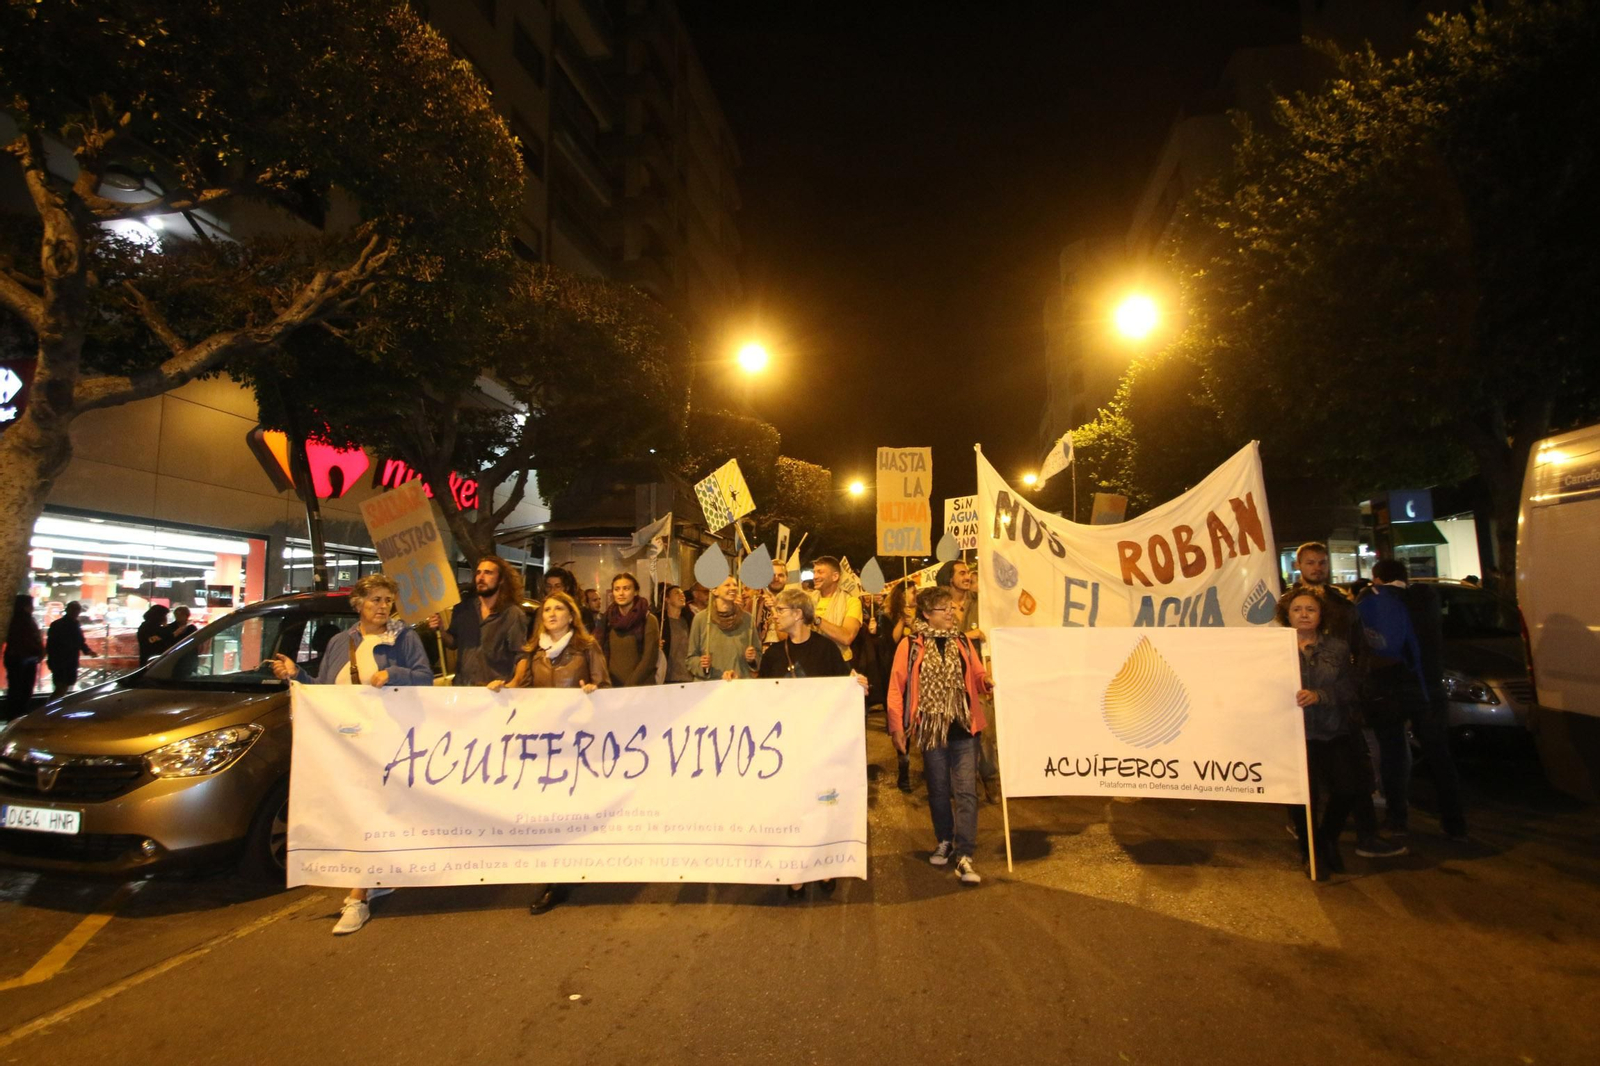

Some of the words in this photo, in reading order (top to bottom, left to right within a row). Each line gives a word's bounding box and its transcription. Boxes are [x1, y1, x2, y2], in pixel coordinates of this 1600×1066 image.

[879, 452, 926, 472] HASTA
[903, 477, 924, 498] LA
[949, 510, 978, 524] AGUA
[376, 520, 437, 560] NUESTRO
[883, 527, 924, 552] GOTA
[993, 490, 1066, 558] NOS
[1117, 491, 1266, 587] ROBAN
[395, 558, 446, 615] RÍO
[1062, 576, 1100, 627] EL
[1134, 586, 1225, 627] AGUA
[382, 708, 649, 796] ACUÍFEROS
[662, 721, 783, 779] VIVOS
[1044, 754, 1179, 779] ACUÍFEROS
[1193, 760, 1263, 783] VIVOS
[1100, 780, 1137, 789] Plataforma
[1149, 782, 1179, 791] Defensa
[1181, 783, 1192, 791] del
[1193, 784, 1213, 794] Agua
[1214, 785, 1224, 793] en
[9, 808, 40, 827] 0454
[49, 811, 75, 830] HNR
[515, 811, 590, 824] Plataforma
[595, 808, 661, 819] ciudadana
[364, 829, 396, 841] para
[403, 826, 416, 837] el
[421, 826, 473, 837] estudio
[478, 828, 486, 837] y
[491, 825, 503, 836] la
[509, 826, 561, 836] defensa
[567, 824, 587, 834] del
[593, 824, 622, 834] agua
[627, 824, 642, 832] en
[647, 823, 659, 832] la
[663, 823, 725, 835] provincia
[729, 823, 744, 833] de
[300, 862, 362, 874] Miembro
[367, 863, 383, 875] de
[389, 862, 403, 874] la
[409, 861, 437, 873] Red
[442, 858, 508, 871] Andaluza
[514, 858, 530, 869] de
[535, 857, 547, 868] la
[553, 856, 644, 868] FUNDACIÓN
[649, 856, 700, 868] NUEVA
[704, 856, 773, 869] CULTURA
[778, 860, 808, 870] DEL
[813, 853, 857, 868] AGUA
